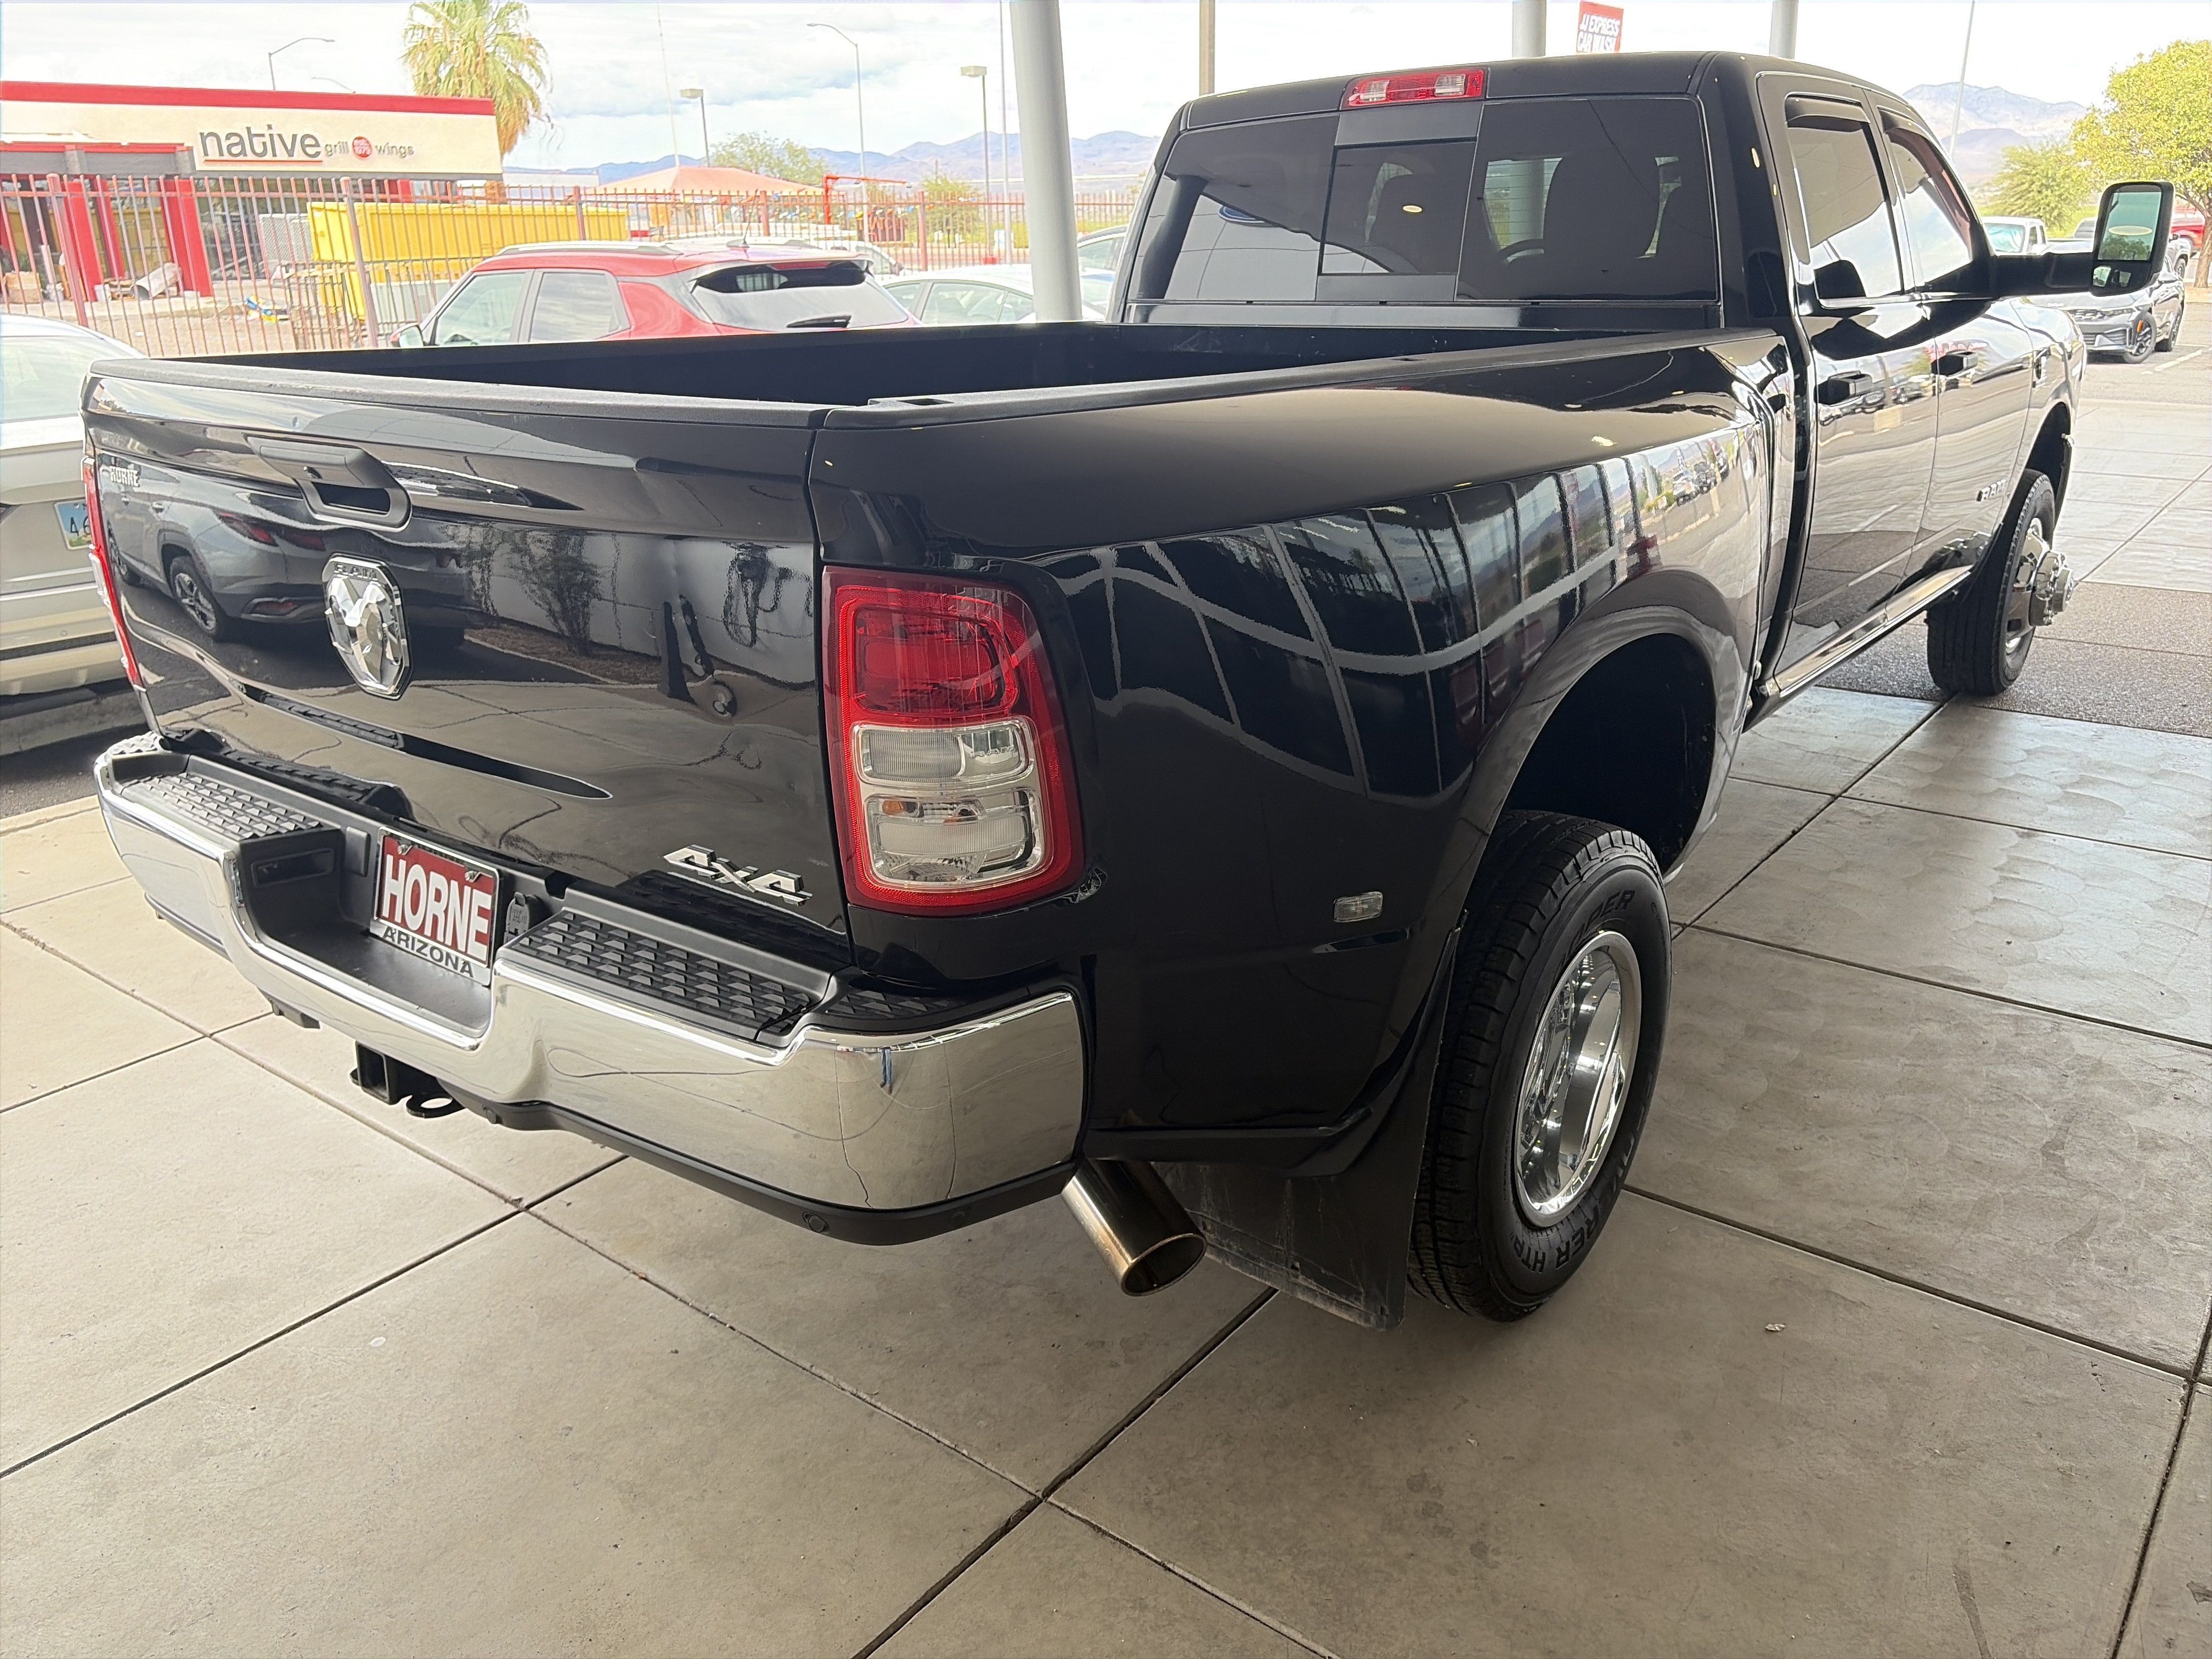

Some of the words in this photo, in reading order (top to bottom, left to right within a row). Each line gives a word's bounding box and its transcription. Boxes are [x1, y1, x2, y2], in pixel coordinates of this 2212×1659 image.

[1588, 15, 1620, 37] EXPRESS
[1577, 31, 1593, 52] CAR
[1590, 34, 1617, 53] WASH
[199, 124, 322, 158] native
[324, 141, 349, 157] grill
[375, 142, 414, 158] wings
[334, 563, 378, 581] RAM
[382, 854, 492, 962] HORNE
[383, 926, 474, 978] ARIZONA
